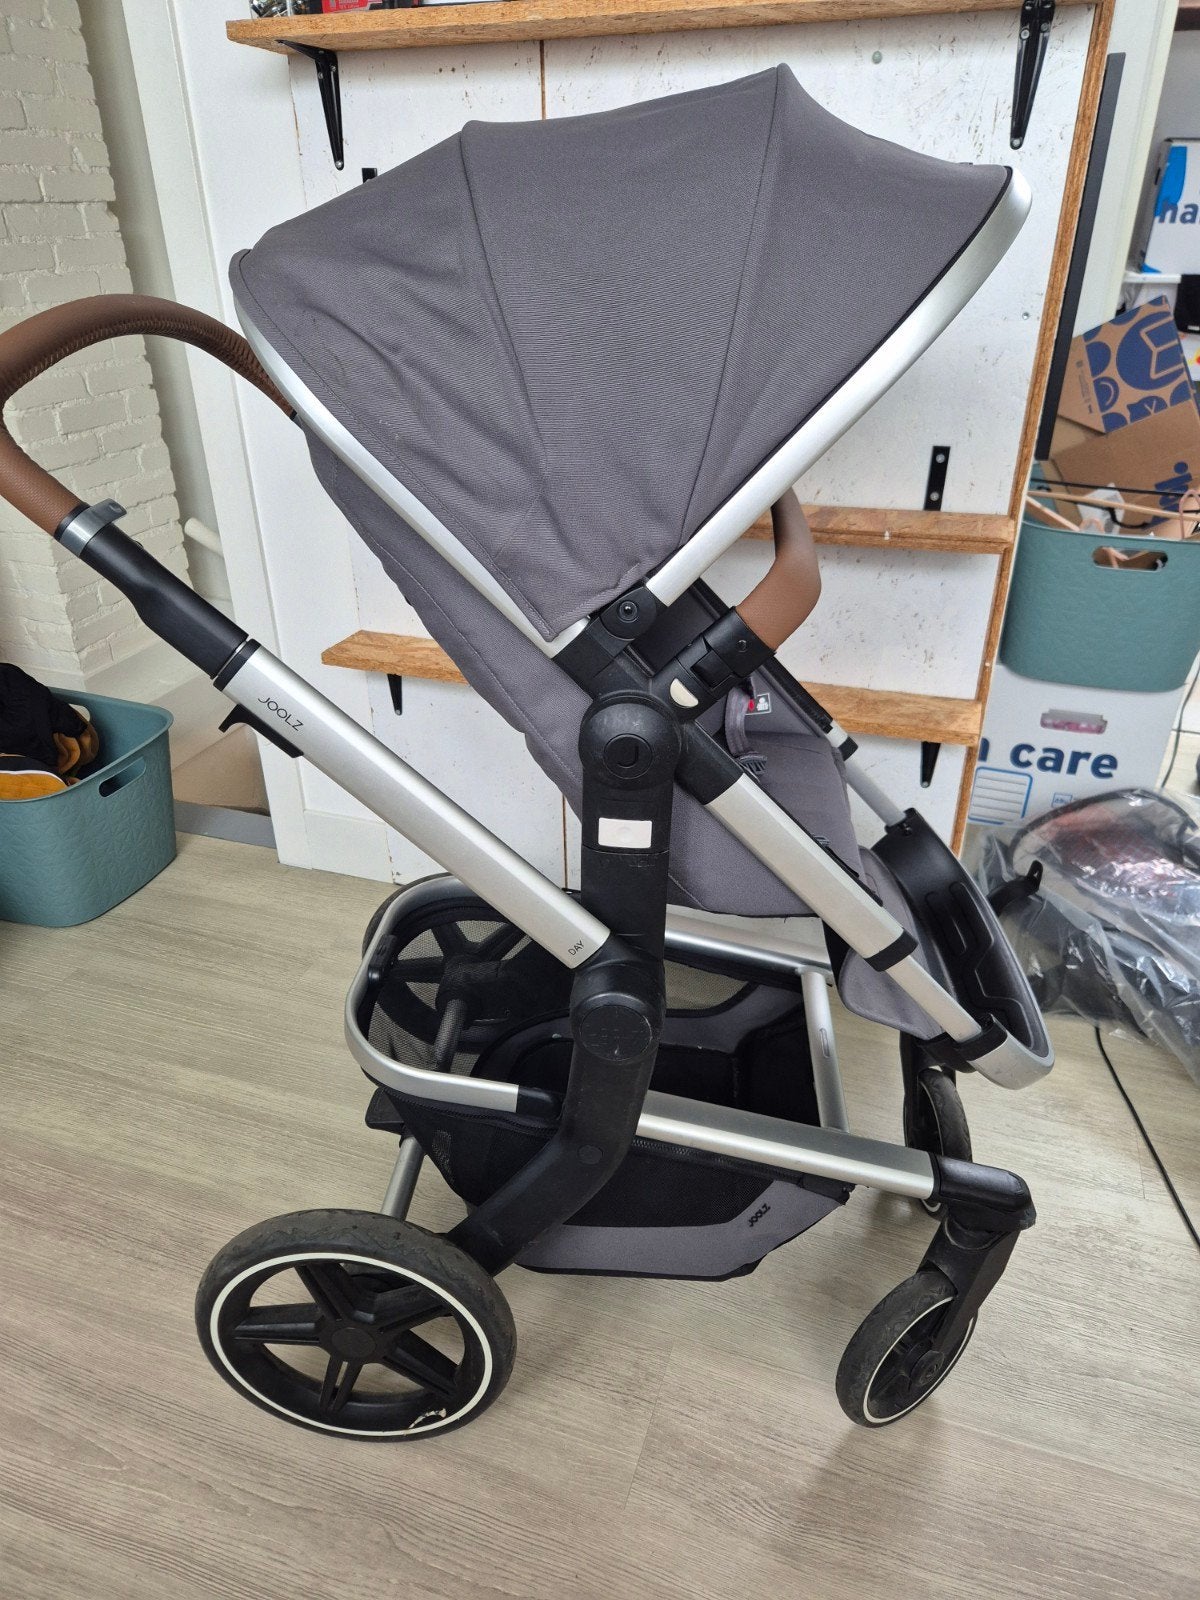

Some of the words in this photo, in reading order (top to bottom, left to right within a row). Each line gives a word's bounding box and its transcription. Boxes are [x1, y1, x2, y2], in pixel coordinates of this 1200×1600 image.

[1158, 196, 1200, 224] ha
[257, 697, 304, 732] JOOLZ
[1009, 742, 1119, 780] care
[567, 939, 585, 956] DAY
